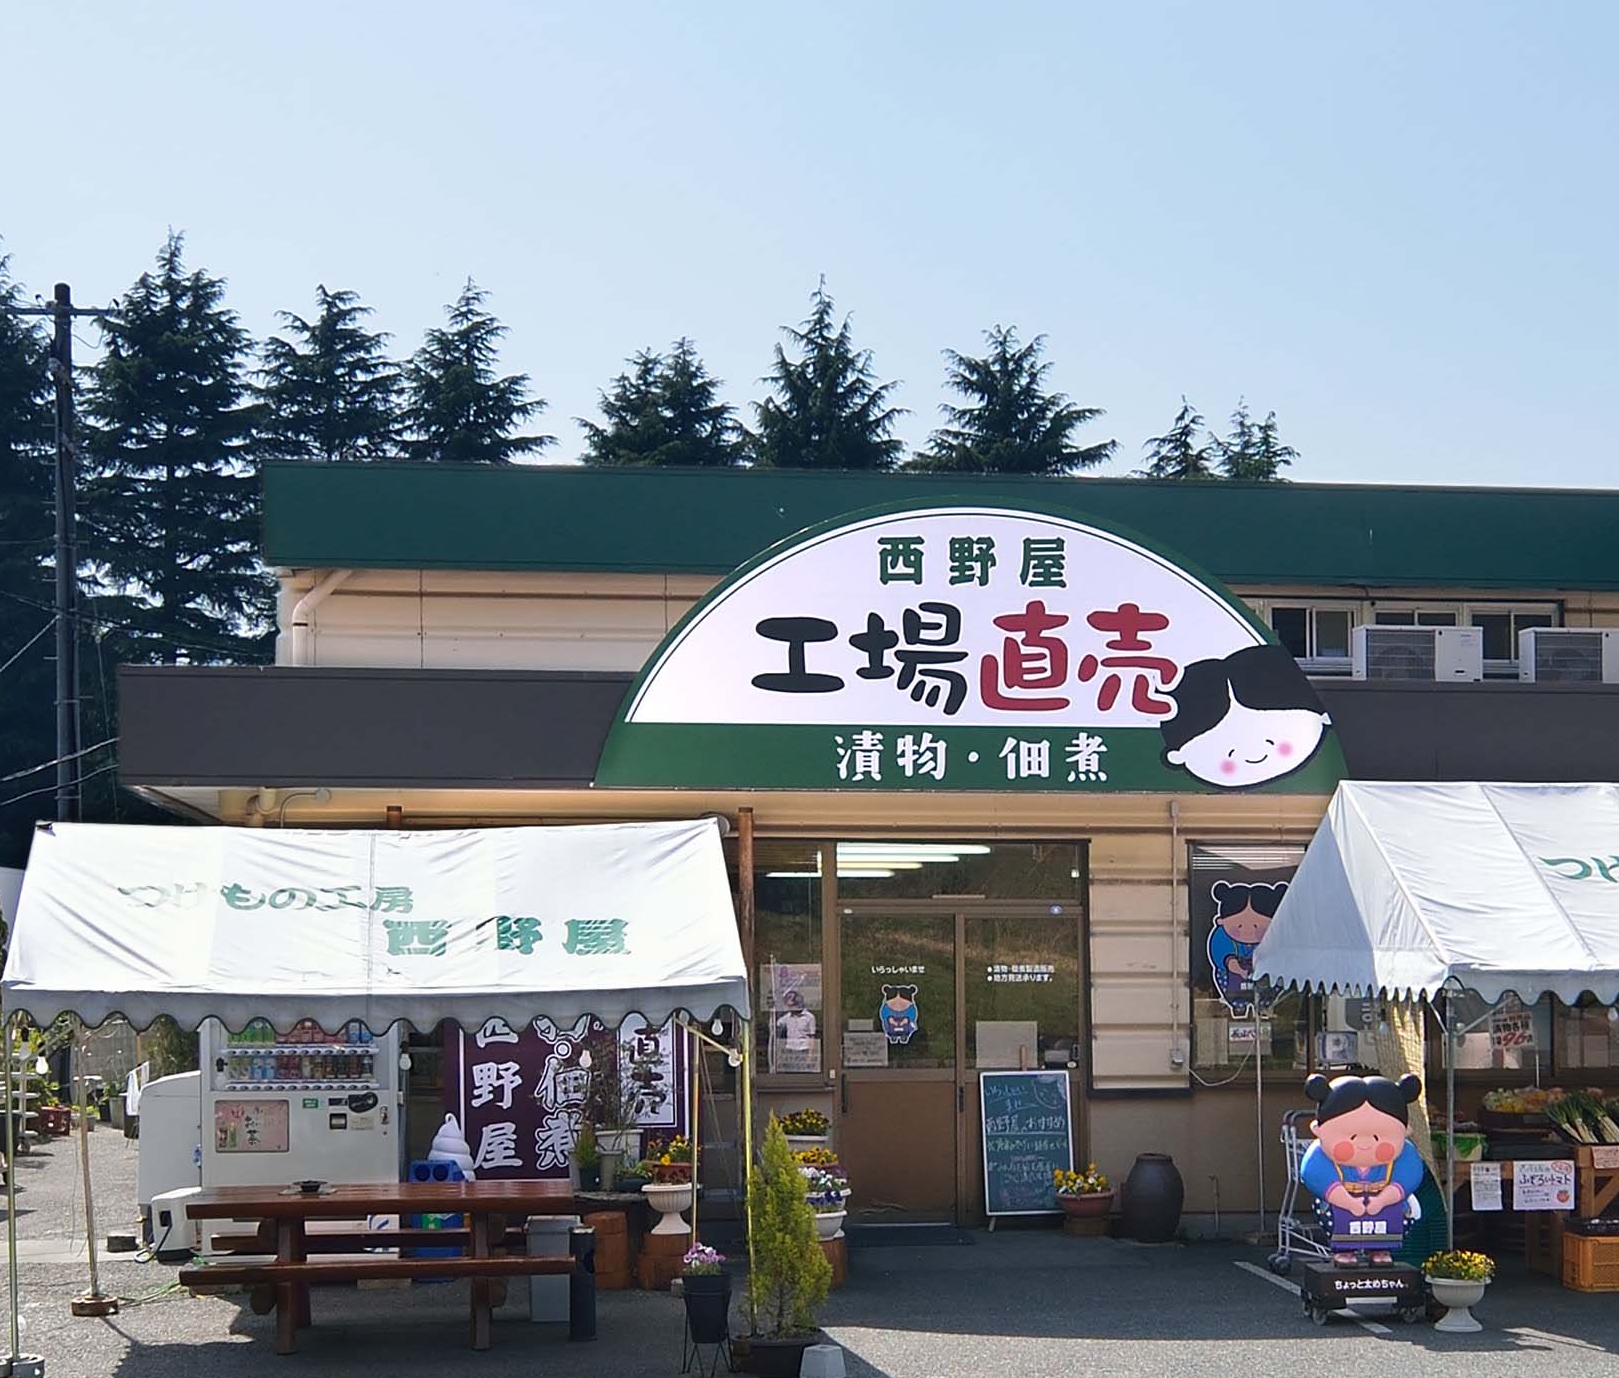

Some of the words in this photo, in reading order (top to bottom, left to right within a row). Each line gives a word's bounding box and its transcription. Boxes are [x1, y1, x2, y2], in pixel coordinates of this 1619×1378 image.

[878, 535, 1068, 589] 西野屋
[751, 599, 1179, 716] 工場直売
[833, 729, 1109, 783] 漬物・佃煮
[117, 882, 414, 912] つけもの工房
